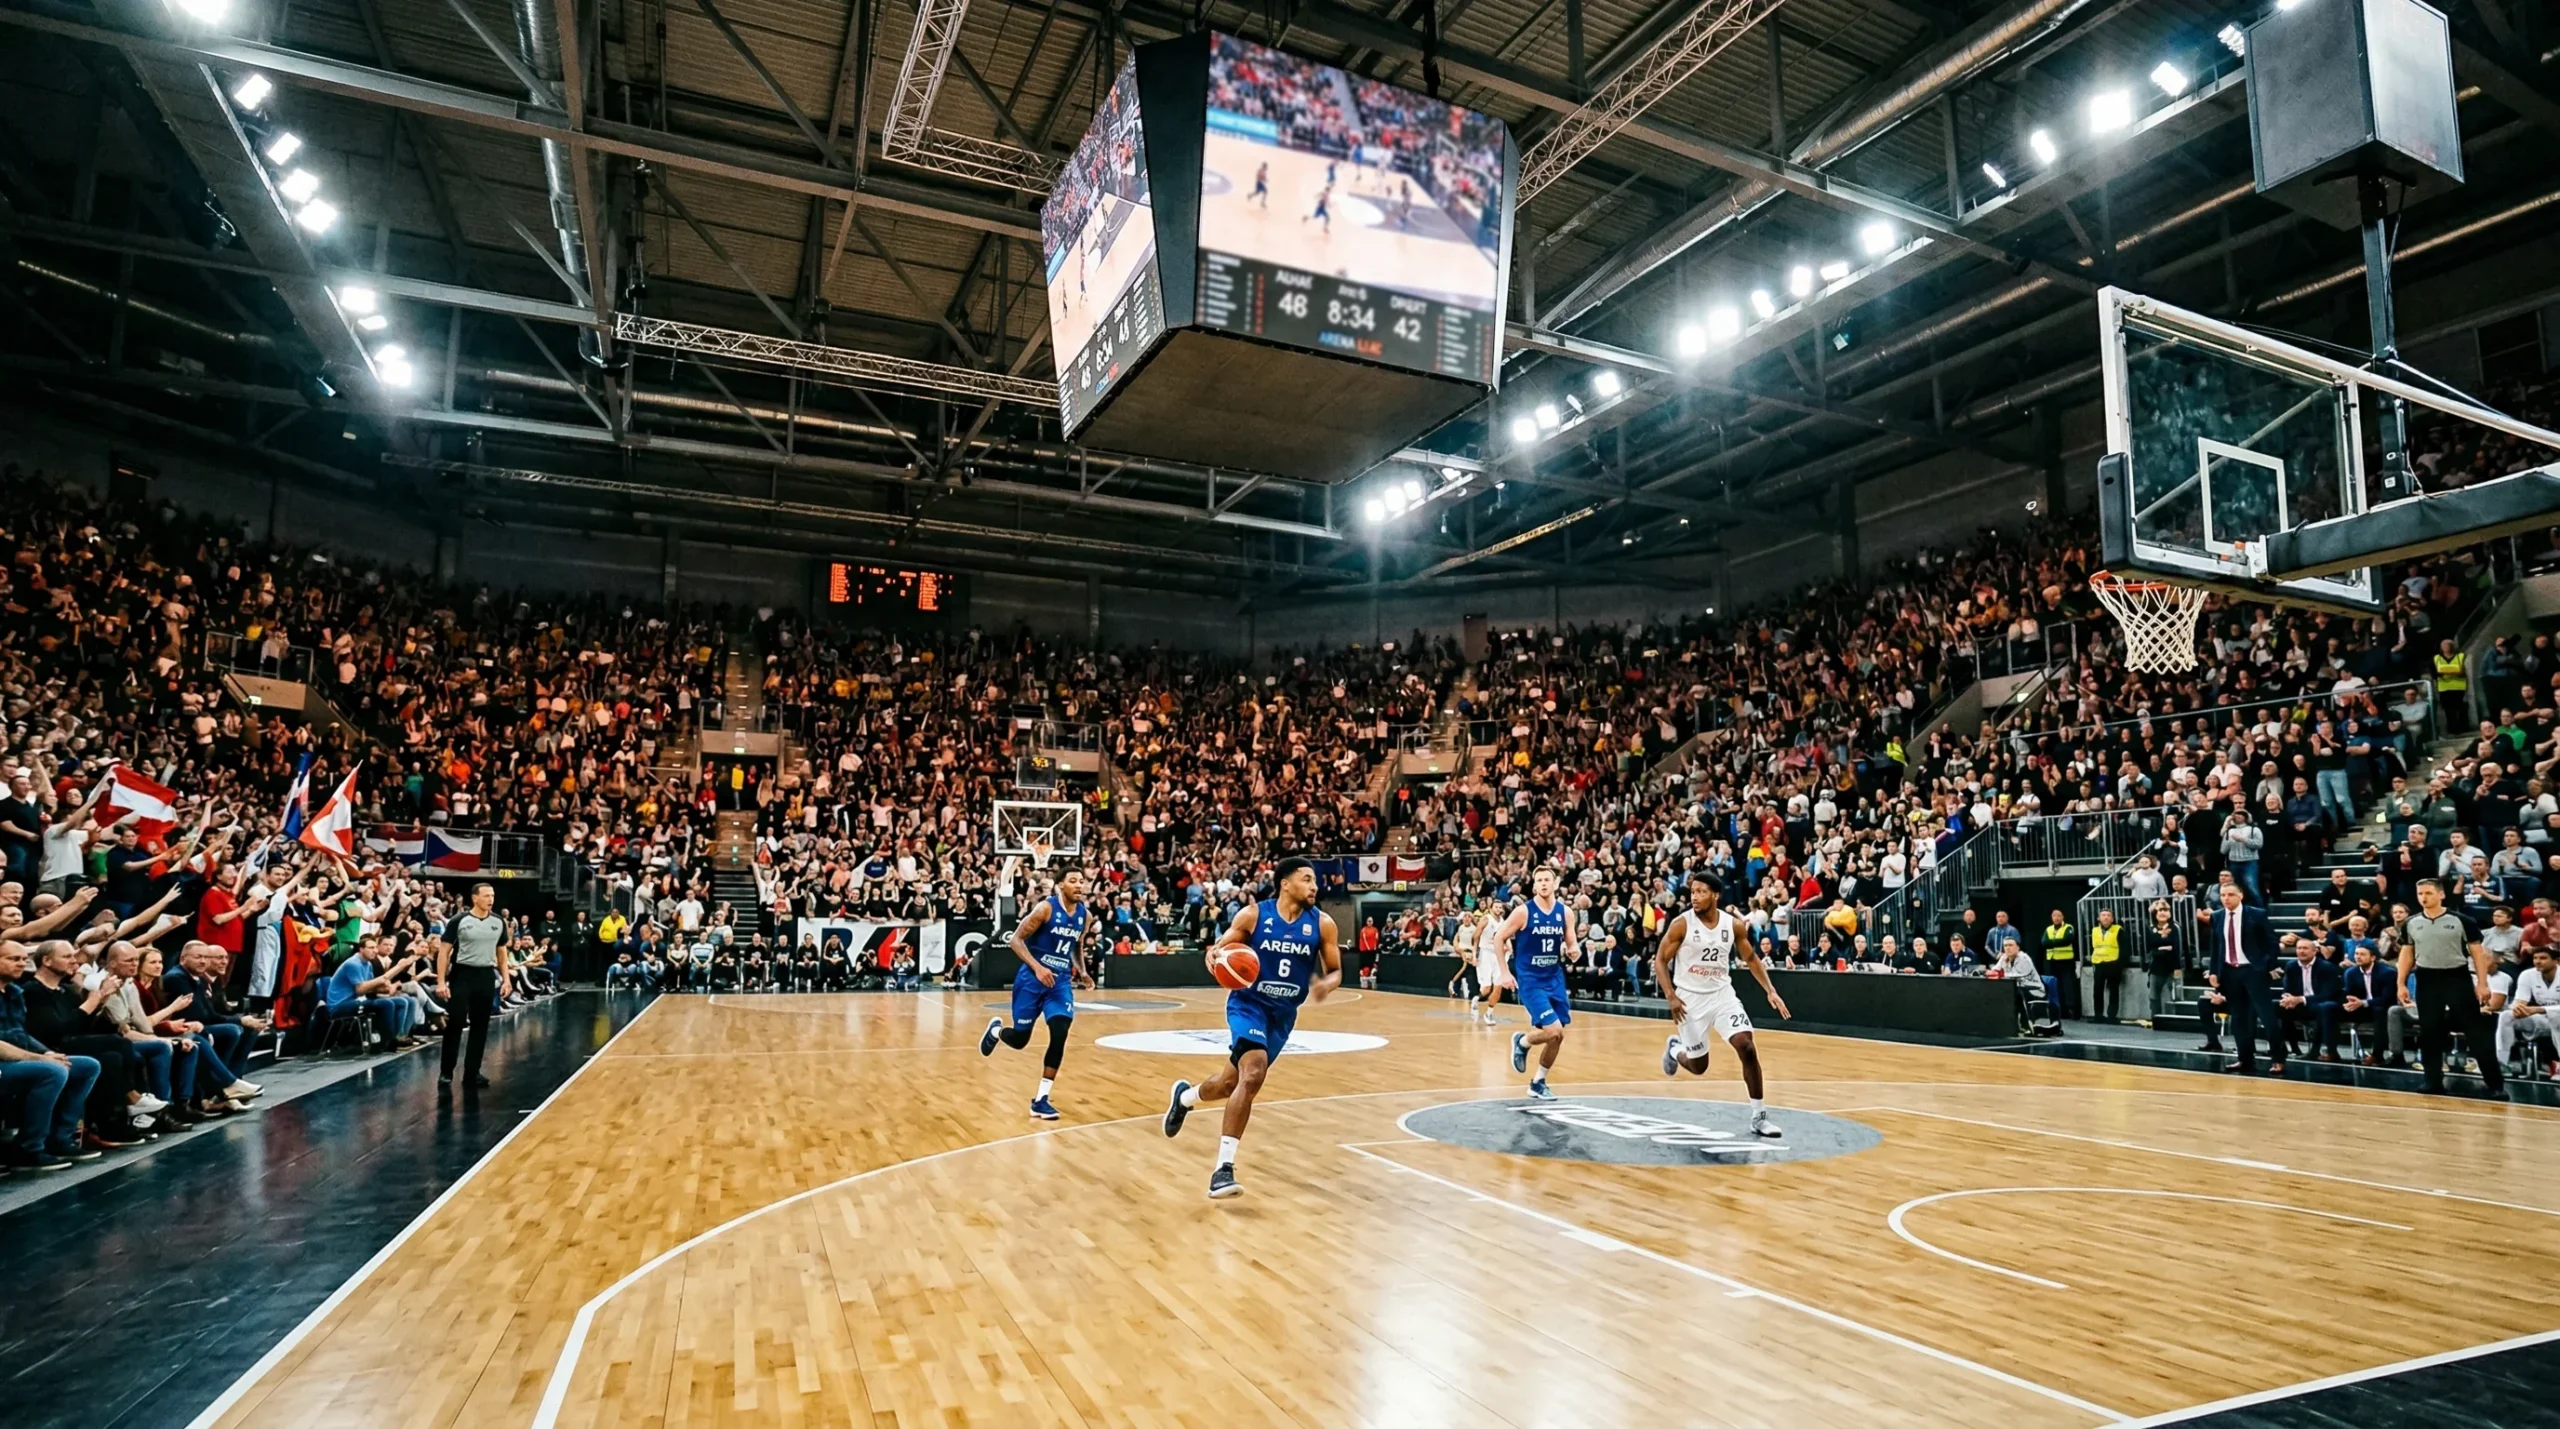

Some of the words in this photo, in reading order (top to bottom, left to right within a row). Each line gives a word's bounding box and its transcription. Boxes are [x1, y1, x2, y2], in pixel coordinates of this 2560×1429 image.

[1327, 299, 1376, 332] 8:34
[1392, 316, 1422, 343] 42
[1055, 939, 1071, 955] 14
[1260, 939, 1311, 956] ARENA
[1541, 938, 1555, 953] 12
[1278, 958, 1291, 978] 6
